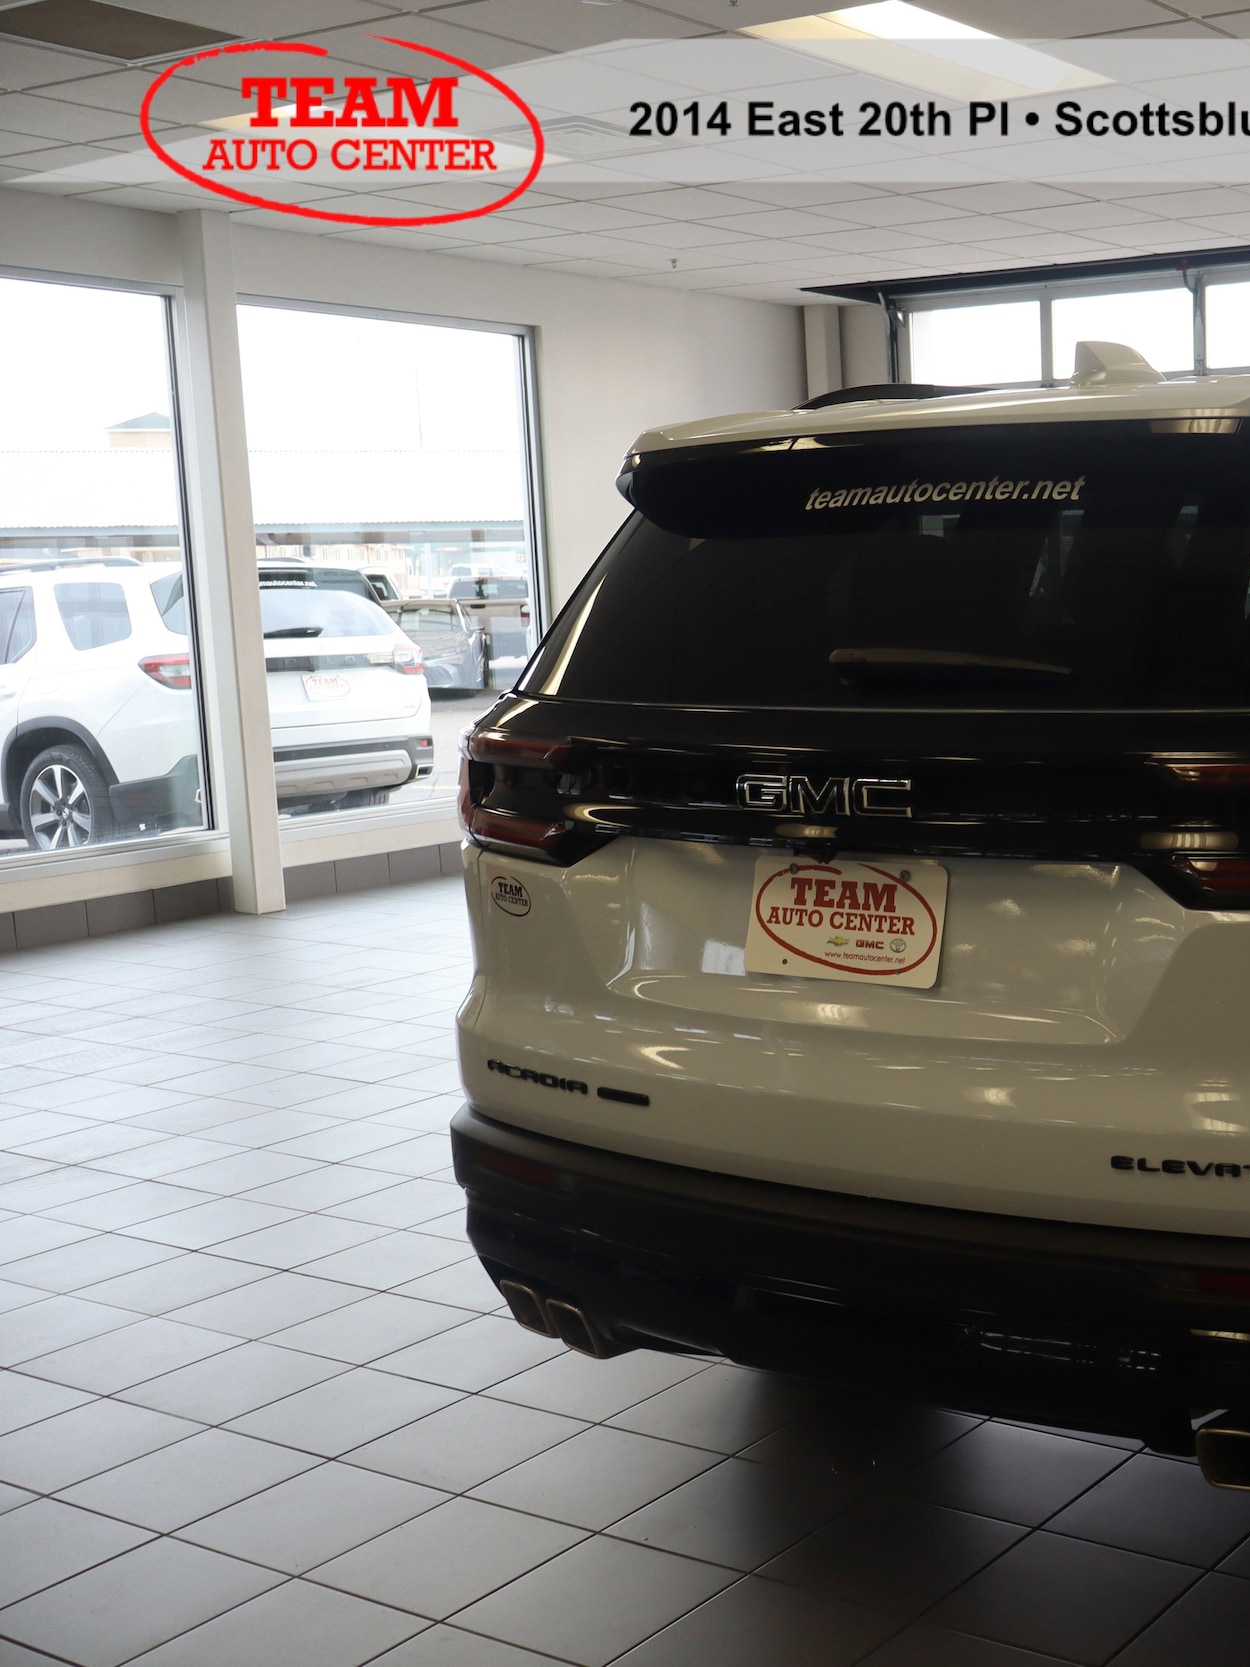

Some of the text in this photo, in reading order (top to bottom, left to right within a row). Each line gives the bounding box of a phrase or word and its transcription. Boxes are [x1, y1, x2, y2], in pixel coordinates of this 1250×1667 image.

[804, 475, 1086, 511] teamautocenter.net
[736, 774, 913, 819] GMC
[498, 882, 523, 898] TEAM
[508, 896, 529, 907] CENTER
[790, 877, 898, 913] TEAM
[767, 906, 916, 936] AUTO CENTER
[824, 950, 906, 965] www.teamautocenter.net
[855, 939, 885, 950] GMC
[487, 1058, 589, 1096] ACADIA
